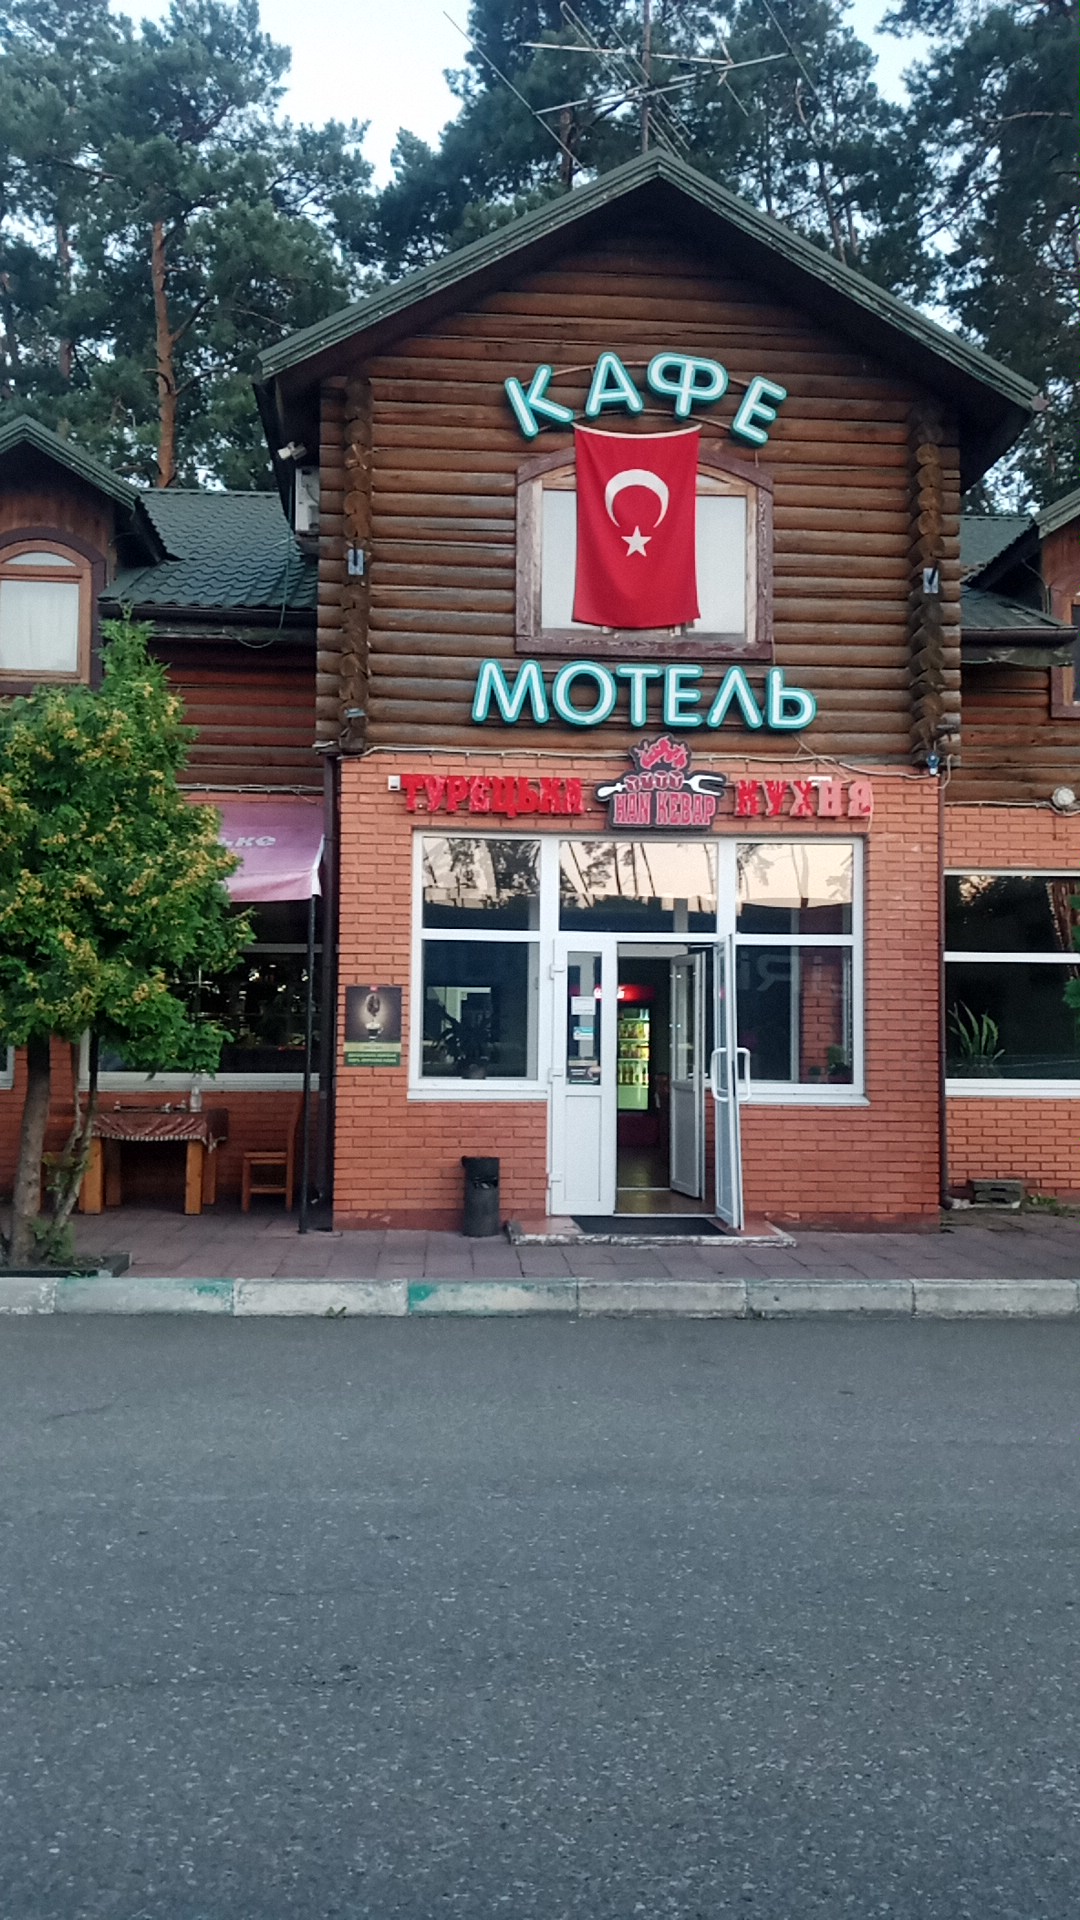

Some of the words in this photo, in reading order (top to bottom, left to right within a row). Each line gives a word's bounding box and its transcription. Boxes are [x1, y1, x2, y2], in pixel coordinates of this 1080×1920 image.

[504, 352, 787, 445] КАФЕ
[472, 659, 816, 730] МОТЕЛЬ
[401, 774, 584, 818] ТУРЕЦЬКА
[735, 779, 872, 817] КУХНЯ
[613, 791, 652, 825] HAN
[656, 792, 716, 826] KEBAP
